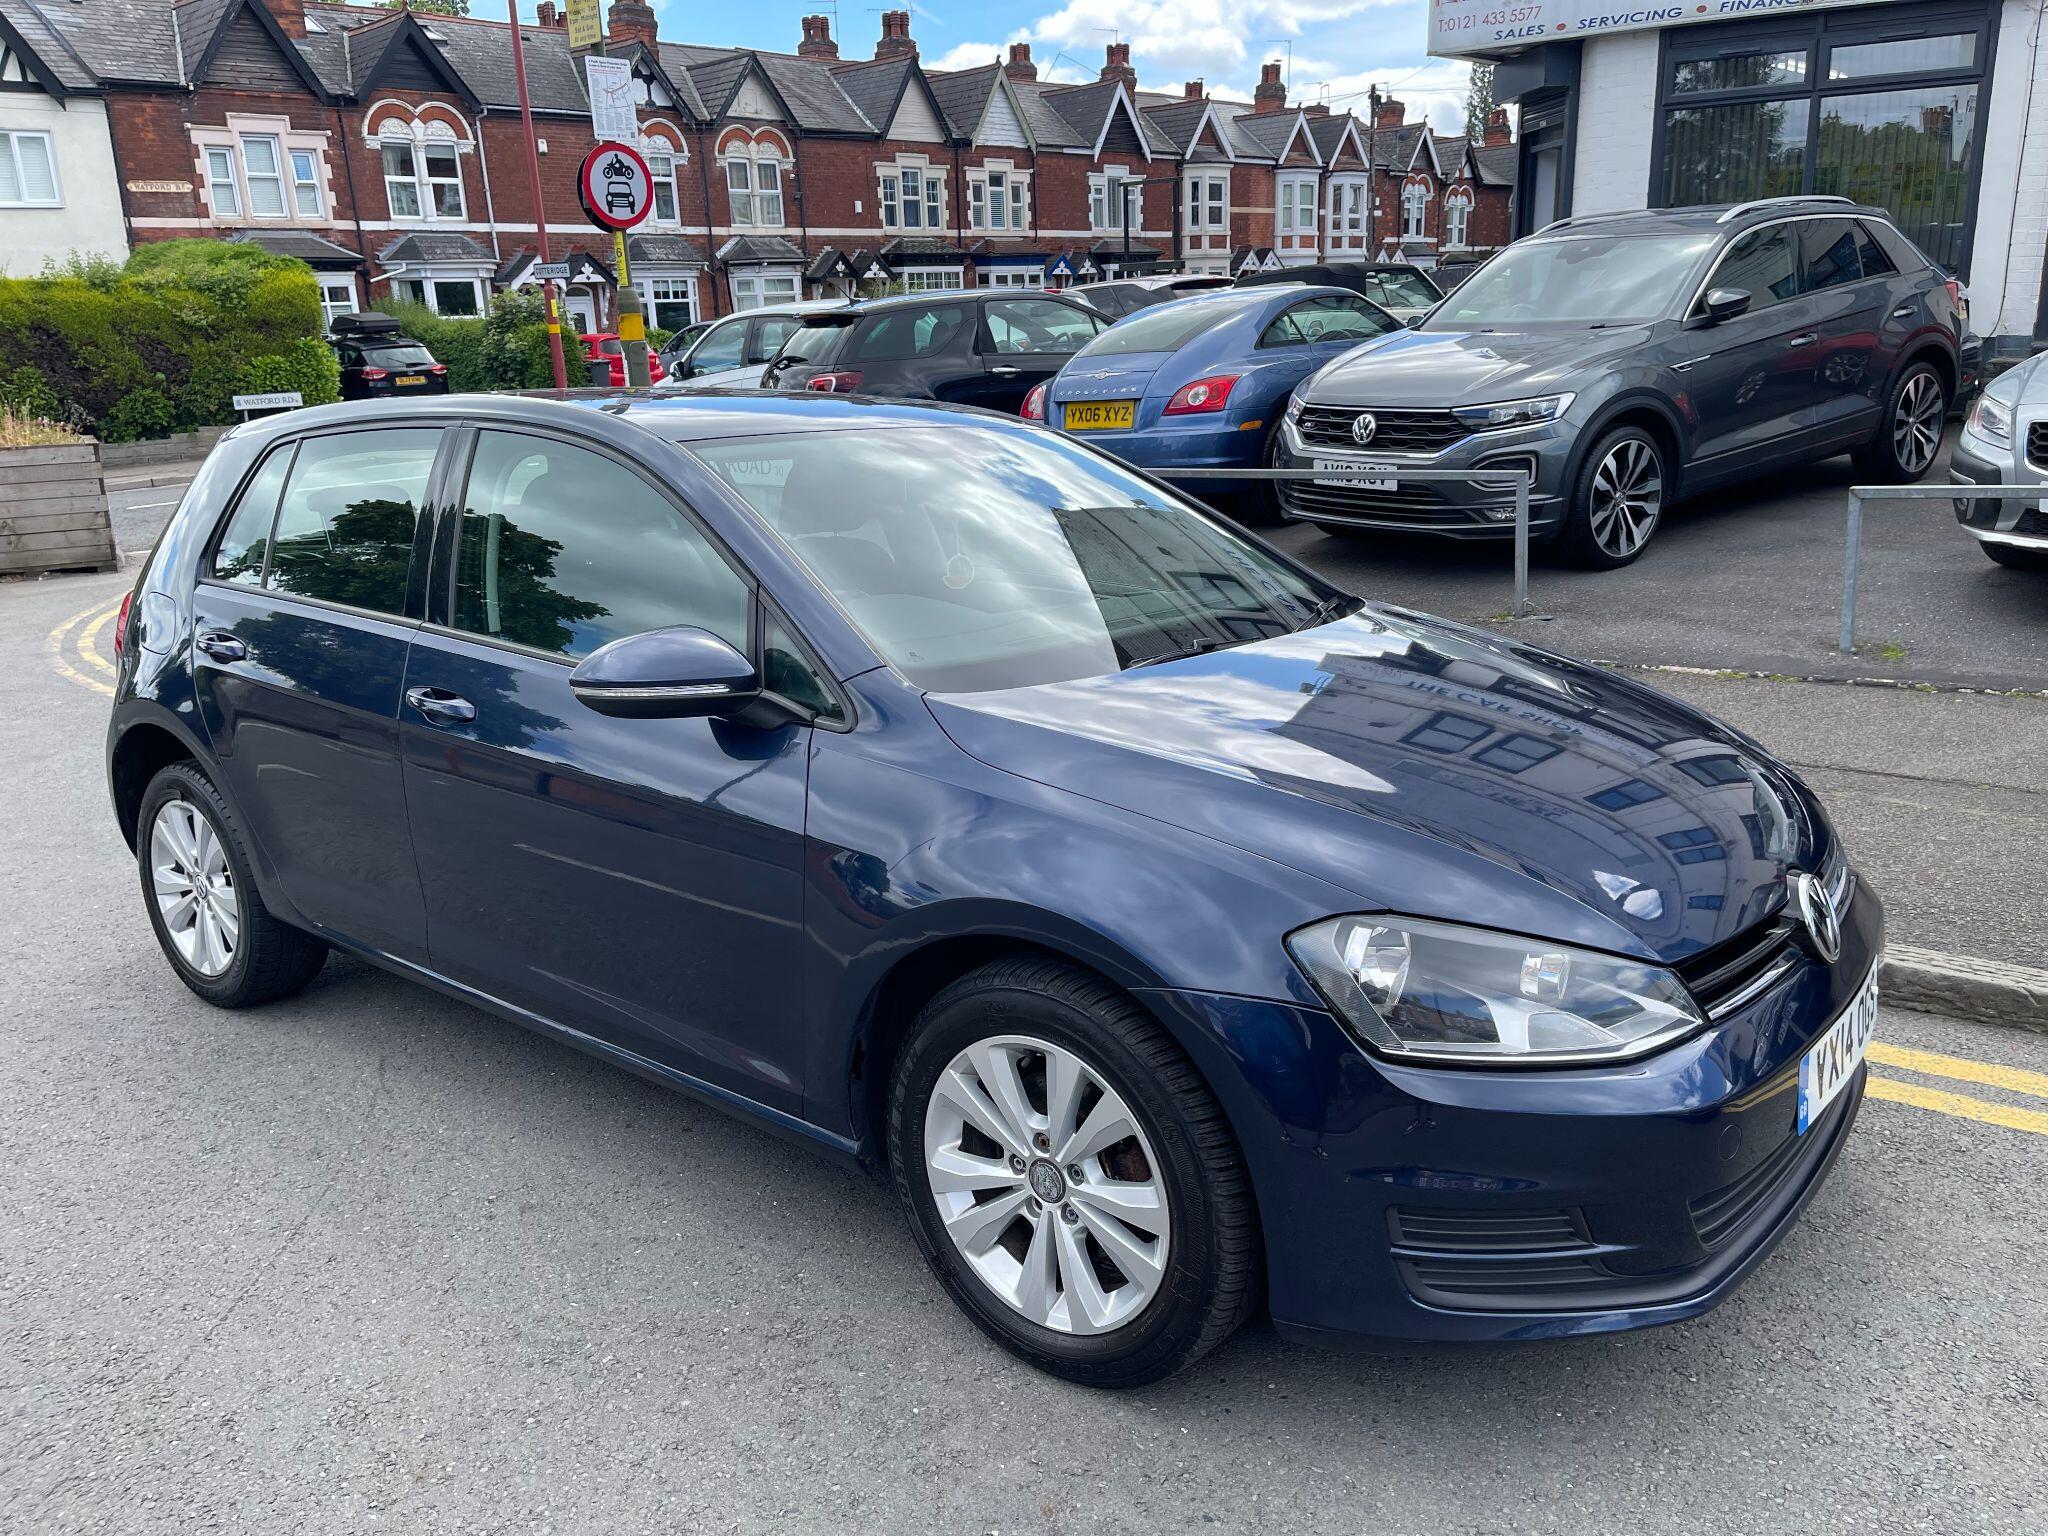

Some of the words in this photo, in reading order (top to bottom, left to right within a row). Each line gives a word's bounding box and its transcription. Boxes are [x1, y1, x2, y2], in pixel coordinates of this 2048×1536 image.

[1438, 14, 1476, 33] T:0121
[1482, 10, 1506, 26] 433
[1509, 5, 1543, 23] 5577
[1493, 24, 1546, 41] SALES
[1576, 7, 1684, 30] SERVICING
[133, 183, 172, 191] WATFORD
[243, 396, 280, 406] WATFORD
[1070, 407, 1101, 423] YX06
[1103, 406, 1130, 422] XYZ
[1816, 1011, 1854, 1100] VX14
